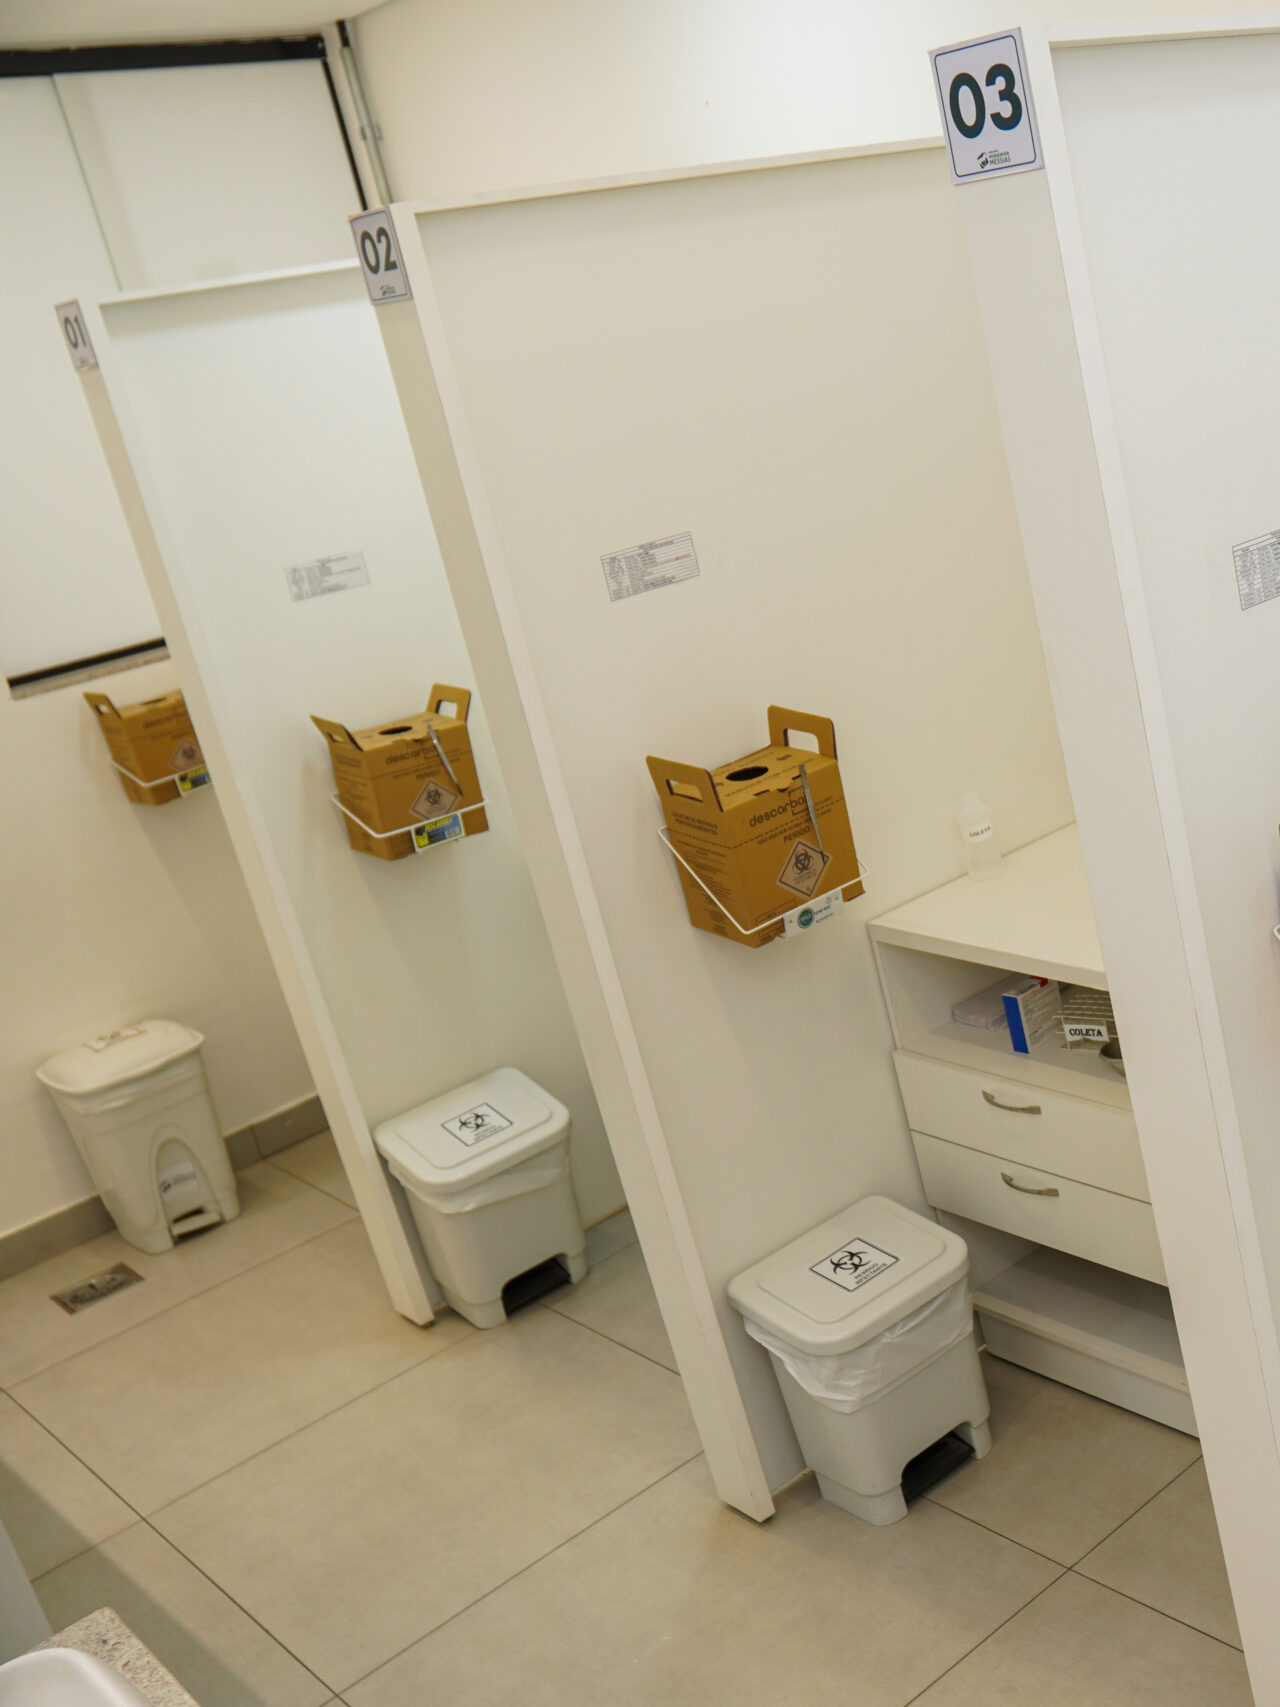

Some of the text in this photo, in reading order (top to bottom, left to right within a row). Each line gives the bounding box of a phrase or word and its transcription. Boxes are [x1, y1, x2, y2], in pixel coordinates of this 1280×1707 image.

[950, 63, 1022, 139] 03
[360, 226, 398, 275] 02
[64, 315, 86, 350] 01
[749, 796, 806, 828] descarbo
[1069, 1028, 1103, 1037] COLETA
